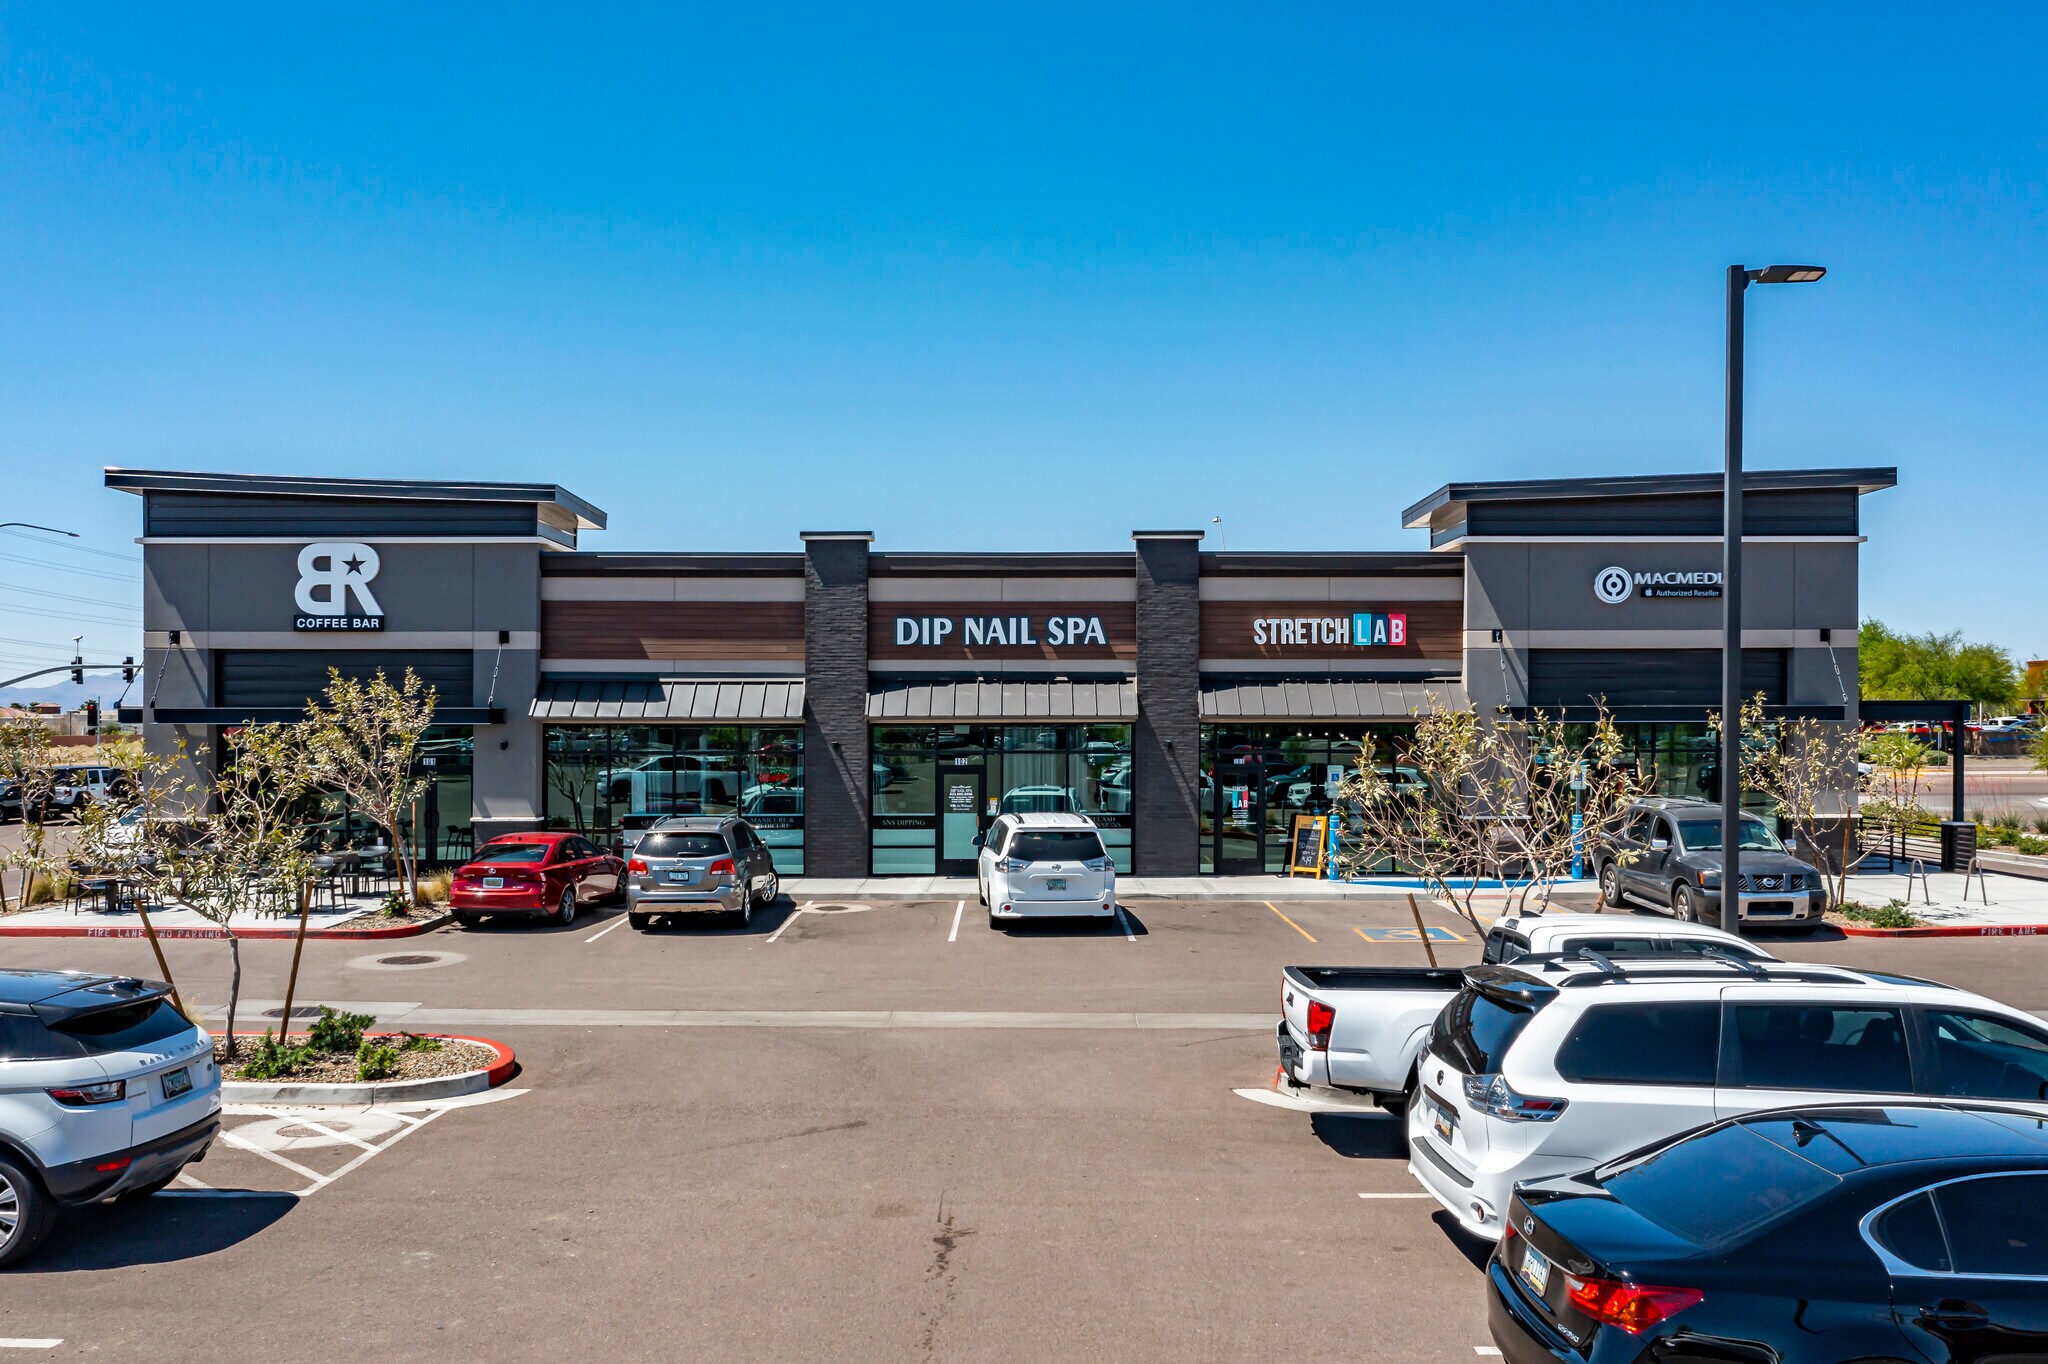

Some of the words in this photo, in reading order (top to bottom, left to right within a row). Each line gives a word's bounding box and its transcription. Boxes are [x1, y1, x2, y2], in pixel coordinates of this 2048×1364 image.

[1633, 572, 1725, 585] MACMEDI
[1656, 589, 1692, 597] Authorized
[1694, 589, 1719, 597] Reseller
[297, 618, 348, 628] COFFEE
[352, 618, 379, 628] BAR
[896, 617, 953, 645] DIP
[964, 617, 1037, 645] NAIL
[1047, 616, 1106, 646] SPA
[1253, 617, 1350, 645] STRETCH
[87, 928, 111, 937] FIRE
[117, 928, 145, 938] LANE
[159, 929, 173, 938] NO
[177, 929, 221, 939] PARKING
[1981, 927, 2004, 936] FIRE
[2011, 926, 2037, 936] LANE
